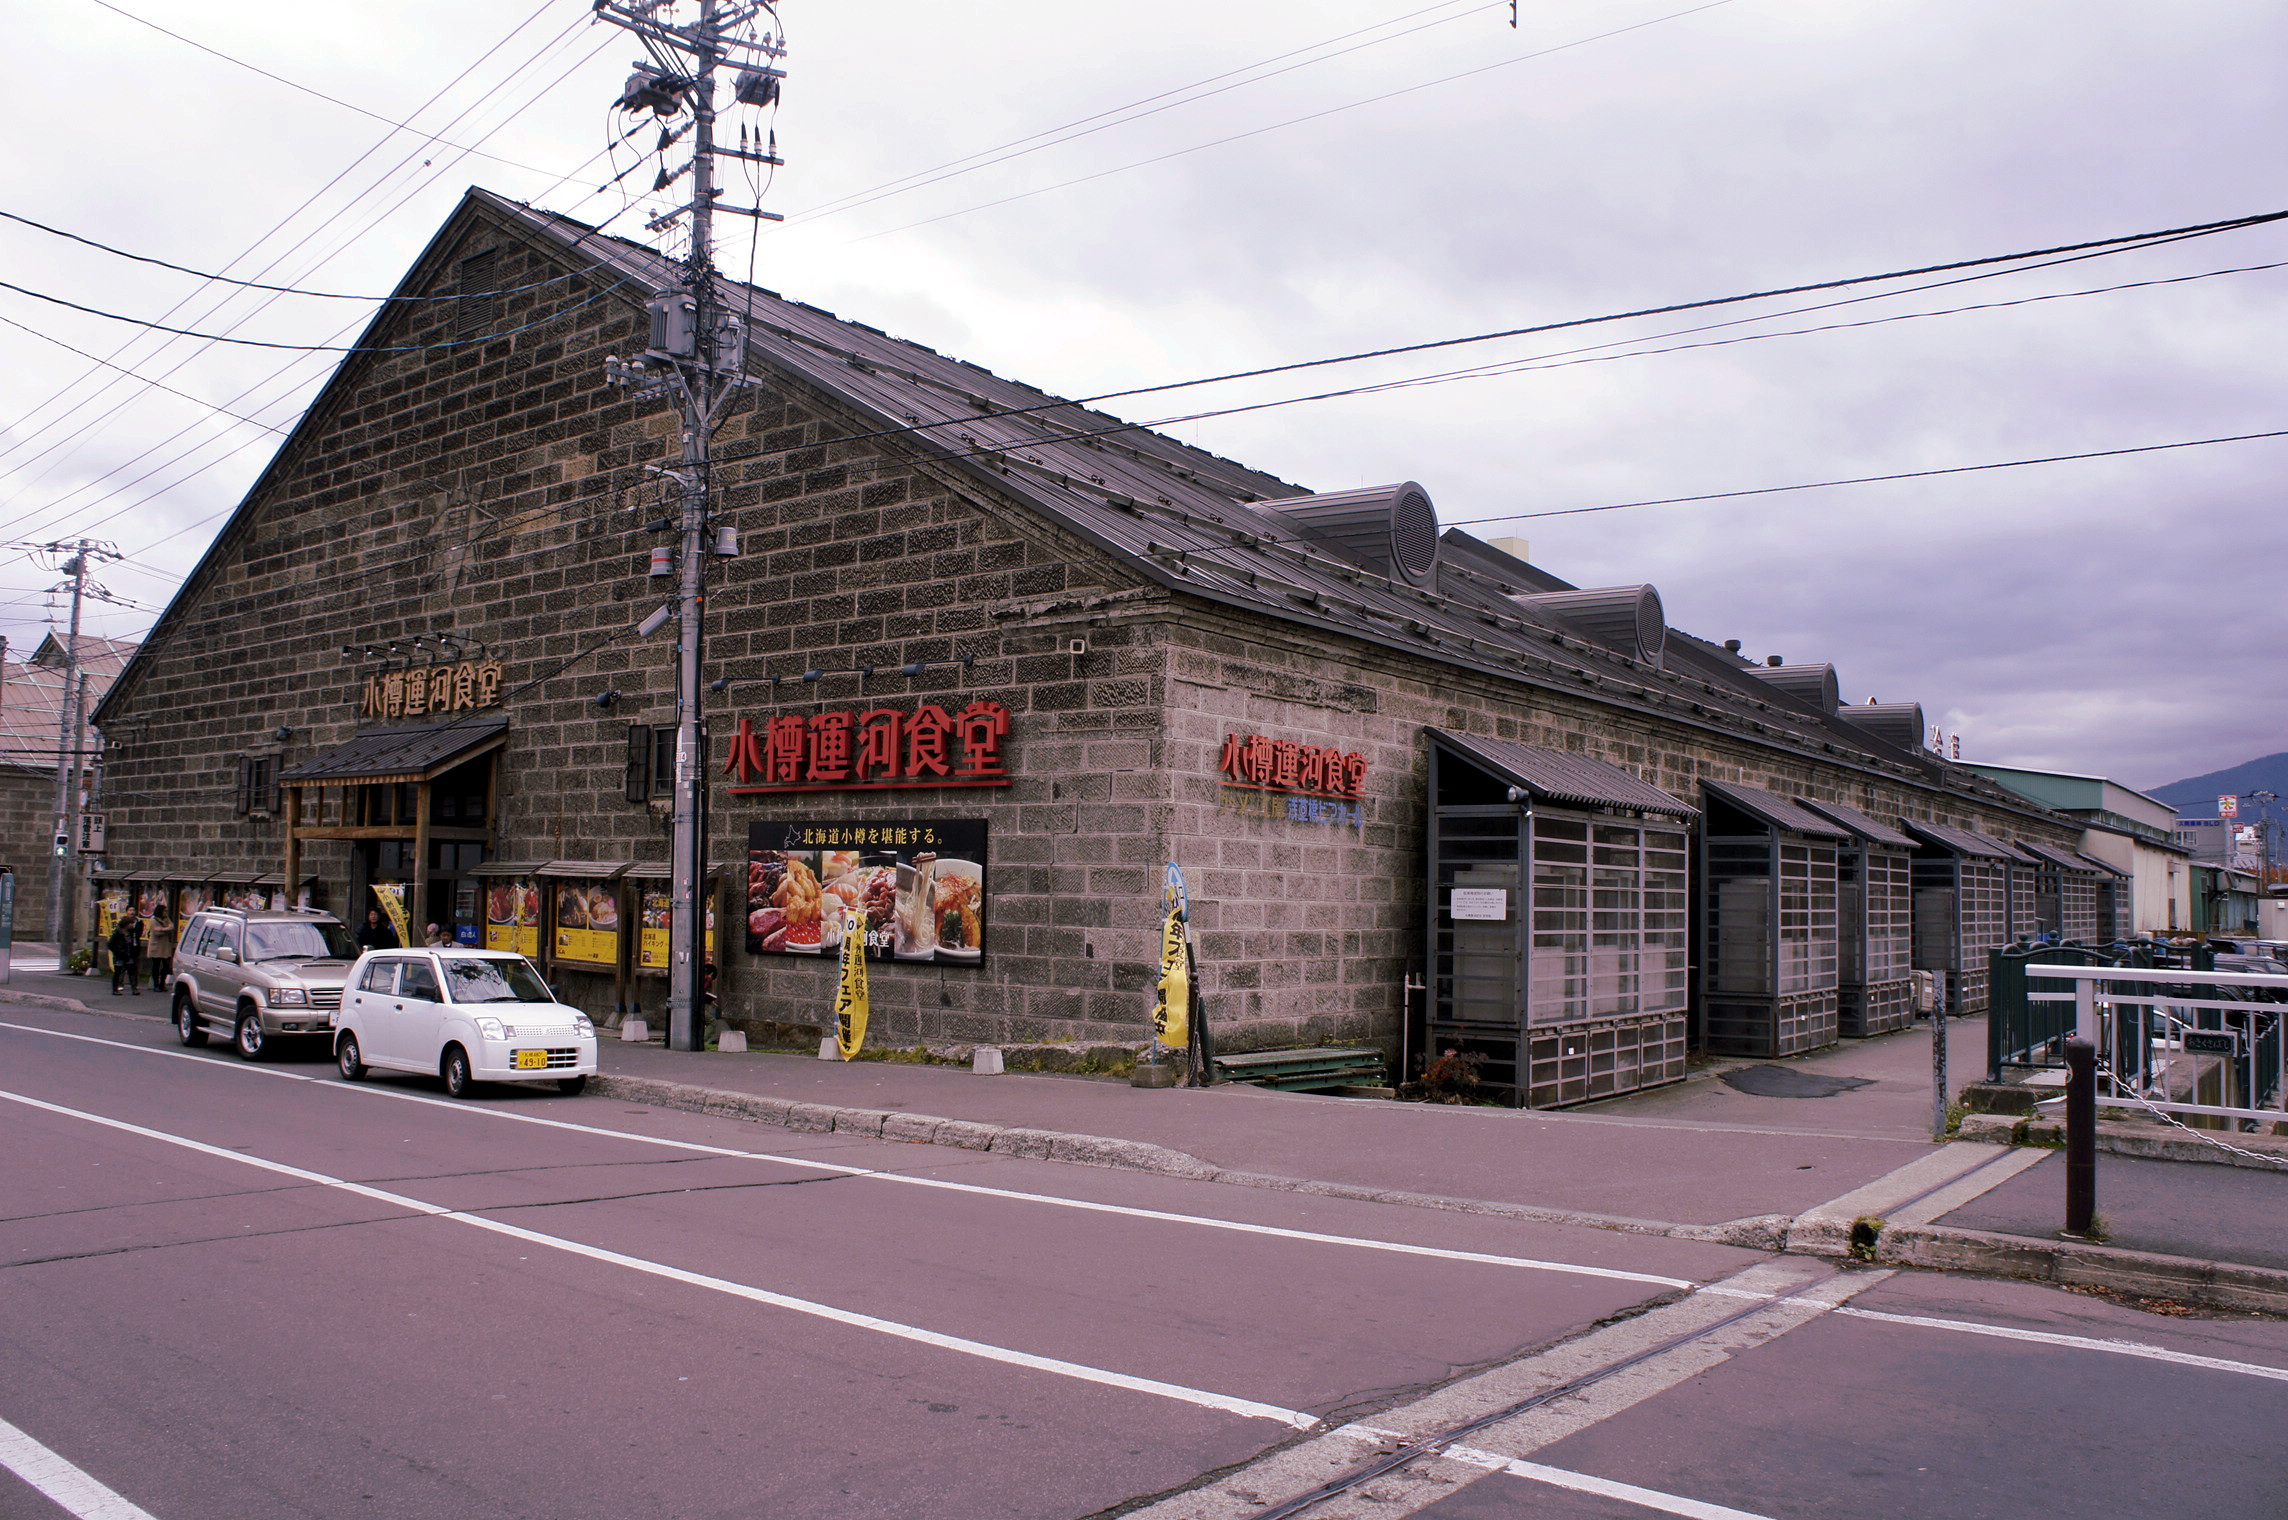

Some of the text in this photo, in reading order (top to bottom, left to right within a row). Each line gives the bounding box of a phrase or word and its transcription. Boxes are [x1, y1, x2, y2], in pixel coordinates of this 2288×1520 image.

[362, 659, 503, 718] 小樽運河食堂
[722, 700, 1010, 784] 小樽運河食堂
[1219, 733, 1369, 795] 小樽運河食堂
[802, 826, 943, 846] 北海道小樽を堪能する。
